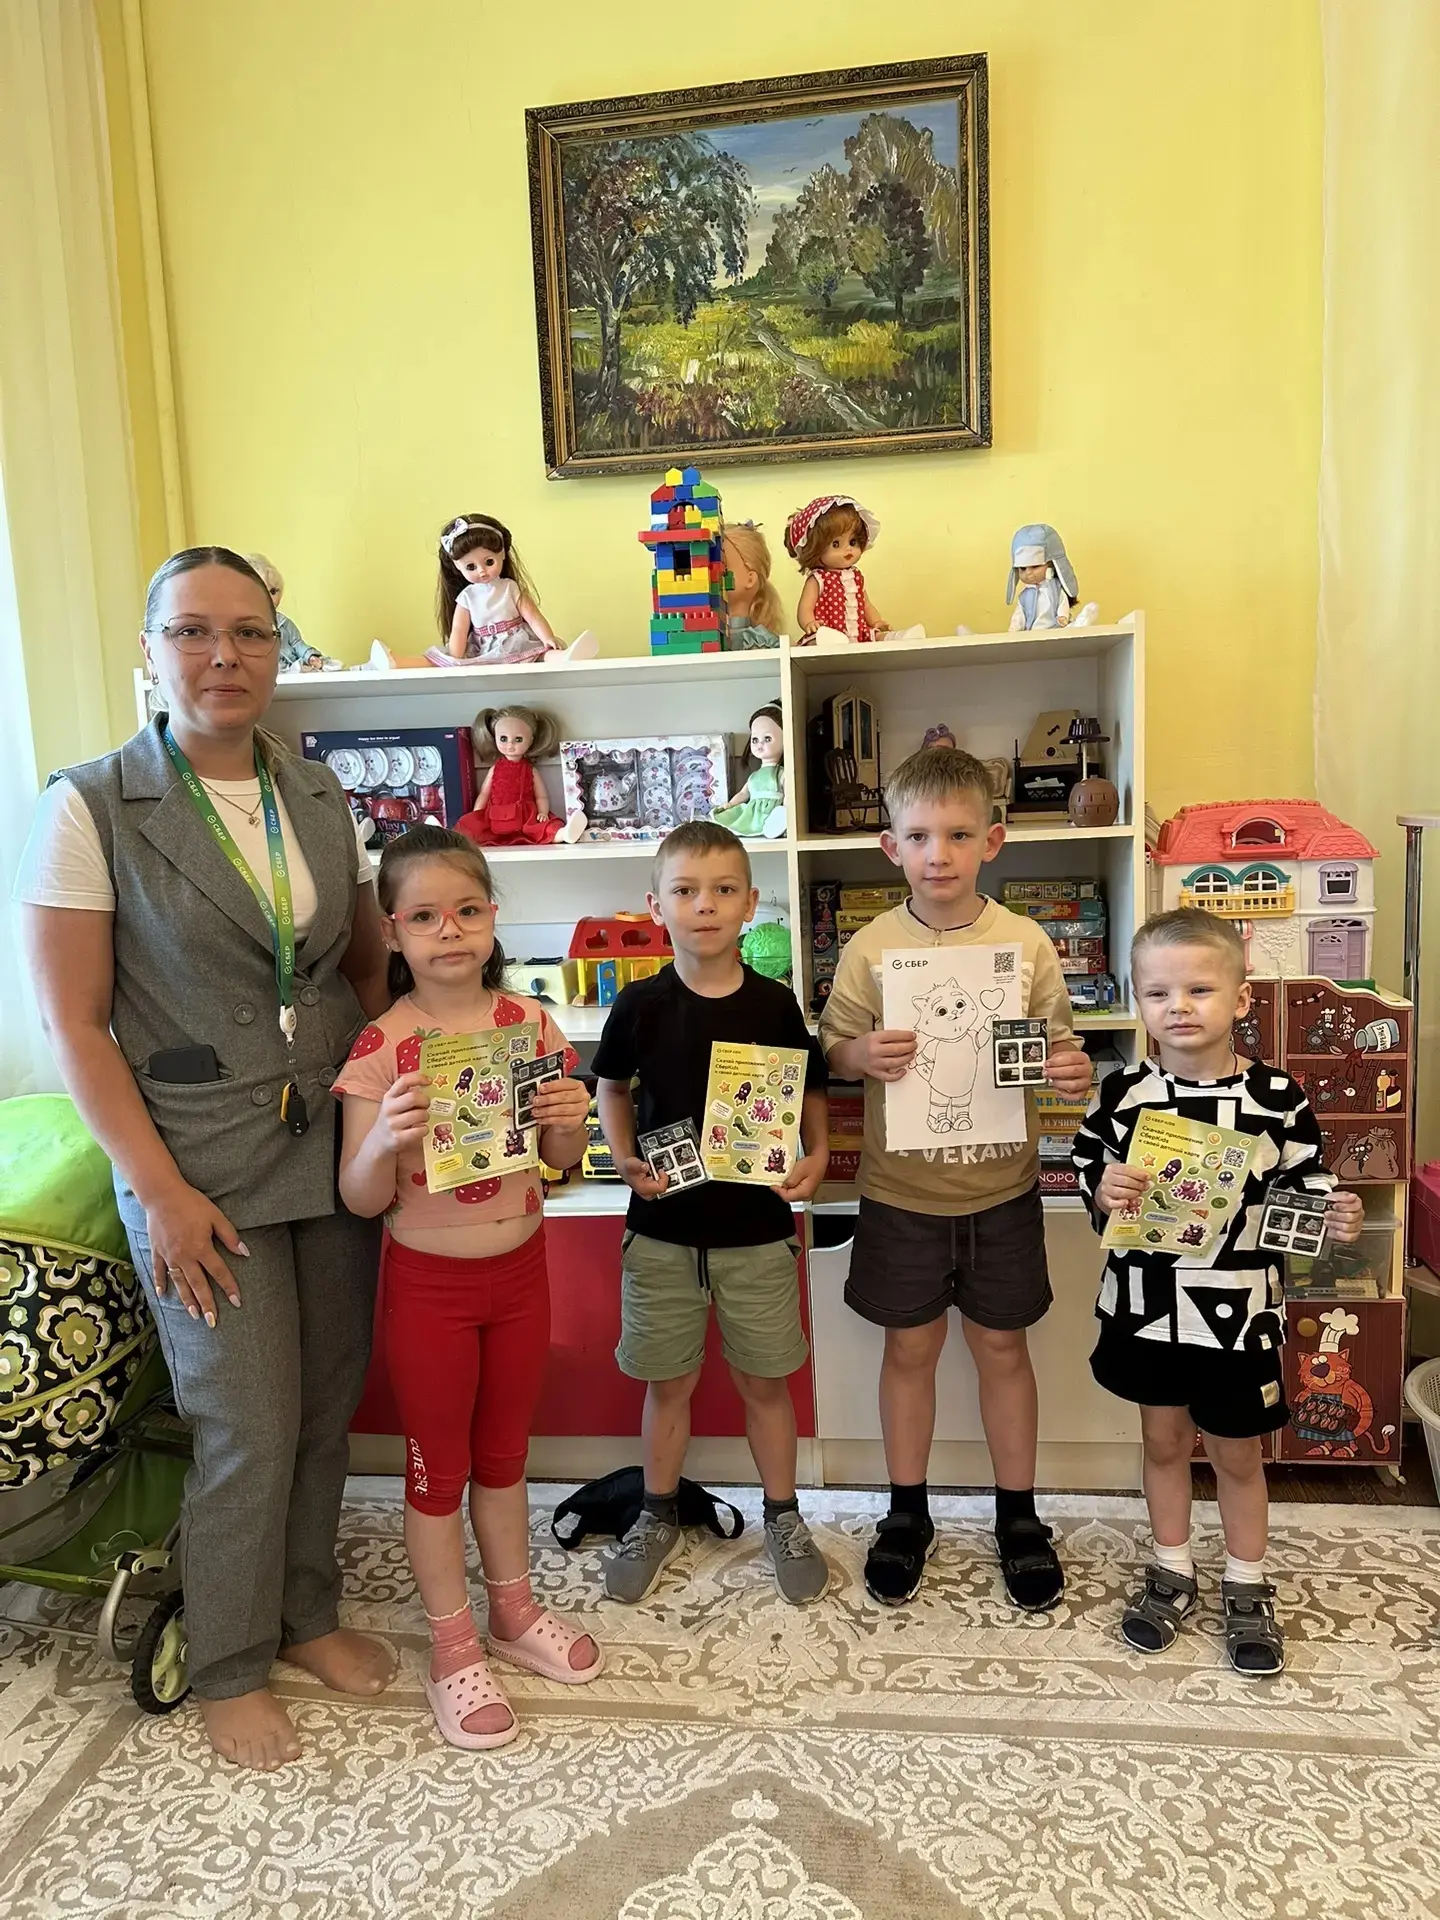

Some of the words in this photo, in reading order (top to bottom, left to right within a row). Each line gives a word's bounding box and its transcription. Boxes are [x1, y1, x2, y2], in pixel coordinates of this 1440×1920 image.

[187, 780, 201, 798] СБЕР
[212, 822, 227, 841] СБЕР
[275, 851, 283, 869] СБЕР
[239, 866, 252, 883] СБЕР
[840, 932, 852, 940] 60
[904, 960, 929, 968] СБЕР
[1142, 1125, 1165, 1135] Скачай
[1166, 1132, 1203, 1144] приложение
[1039, 1172, 1078, 1183] NOPO
[410, 1438, 426, 1472] CUTE
